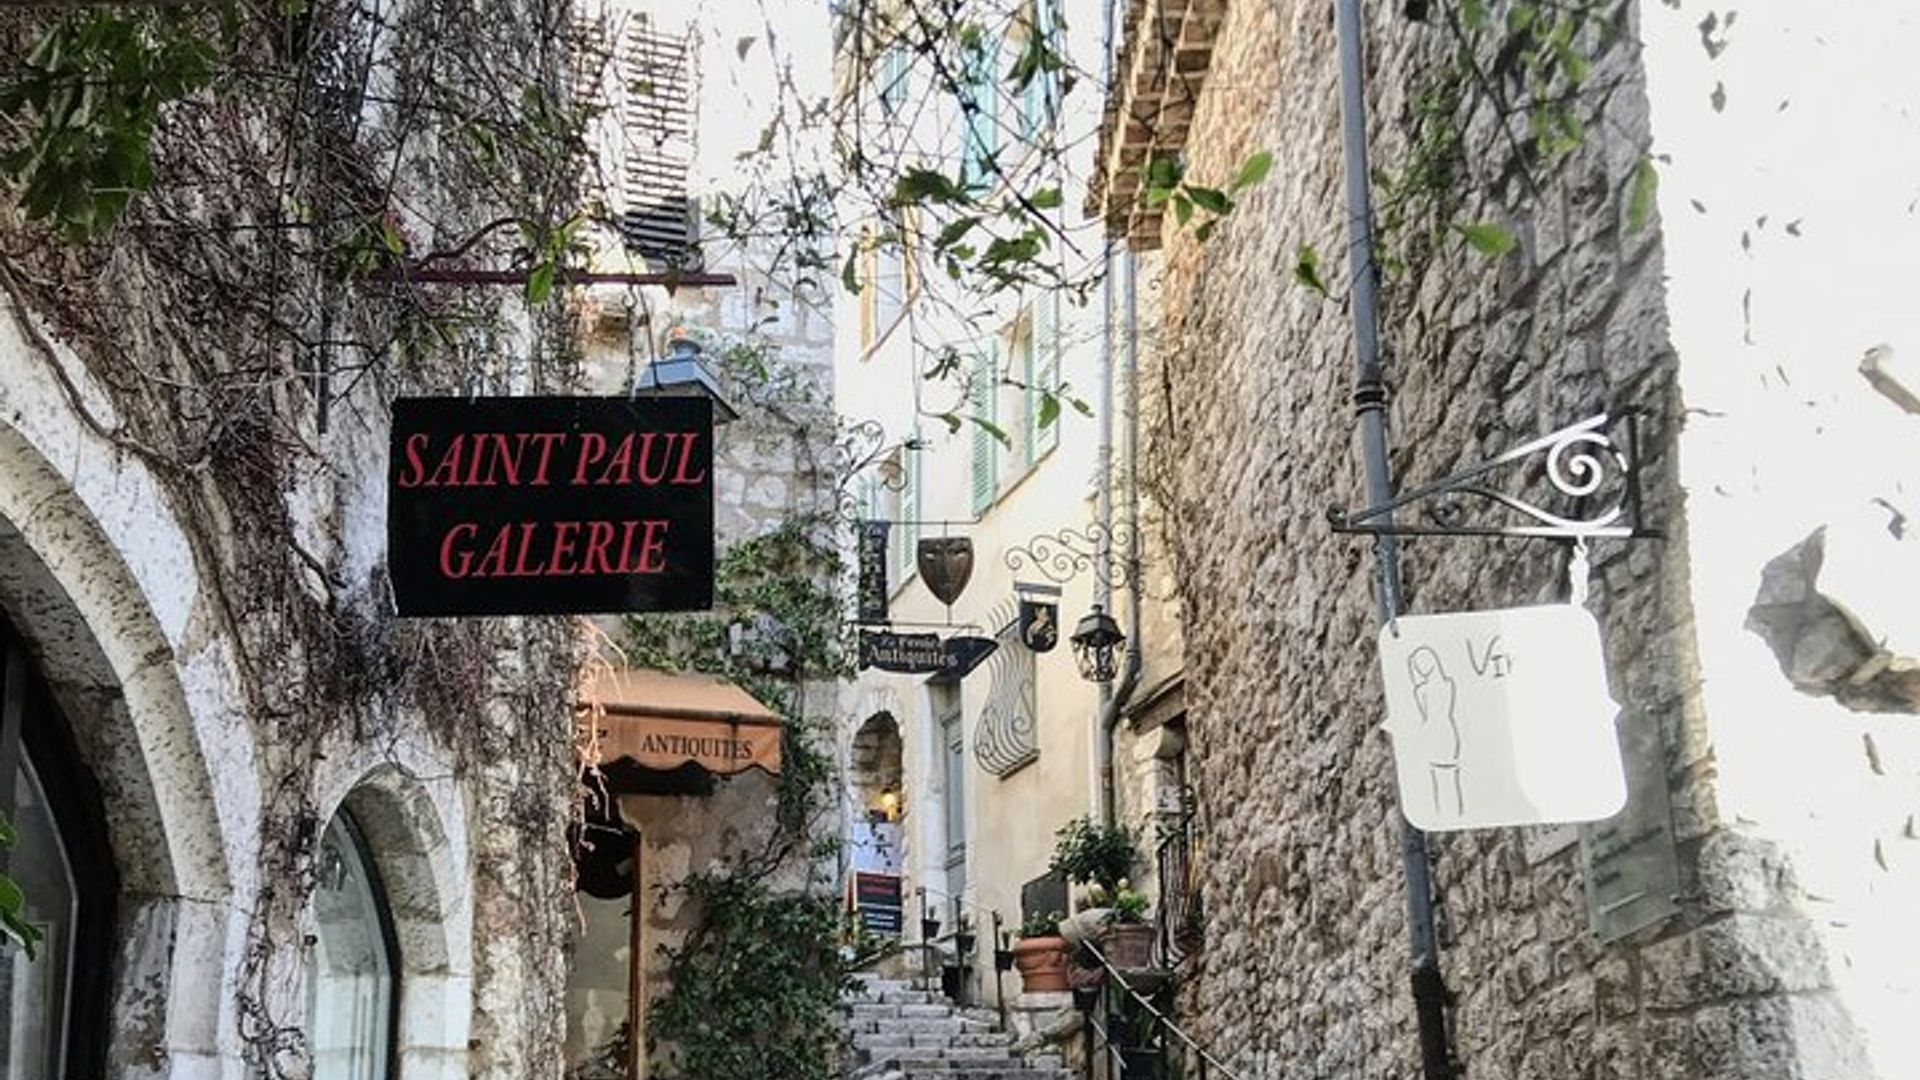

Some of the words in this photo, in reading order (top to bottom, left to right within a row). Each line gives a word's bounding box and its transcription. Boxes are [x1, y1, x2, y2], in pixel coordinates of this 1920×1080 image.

[399, 432, 567, 488] SAINT
[571, 431, 706, 486] PAUL
[438, 520, 671, 579] GALERIE
